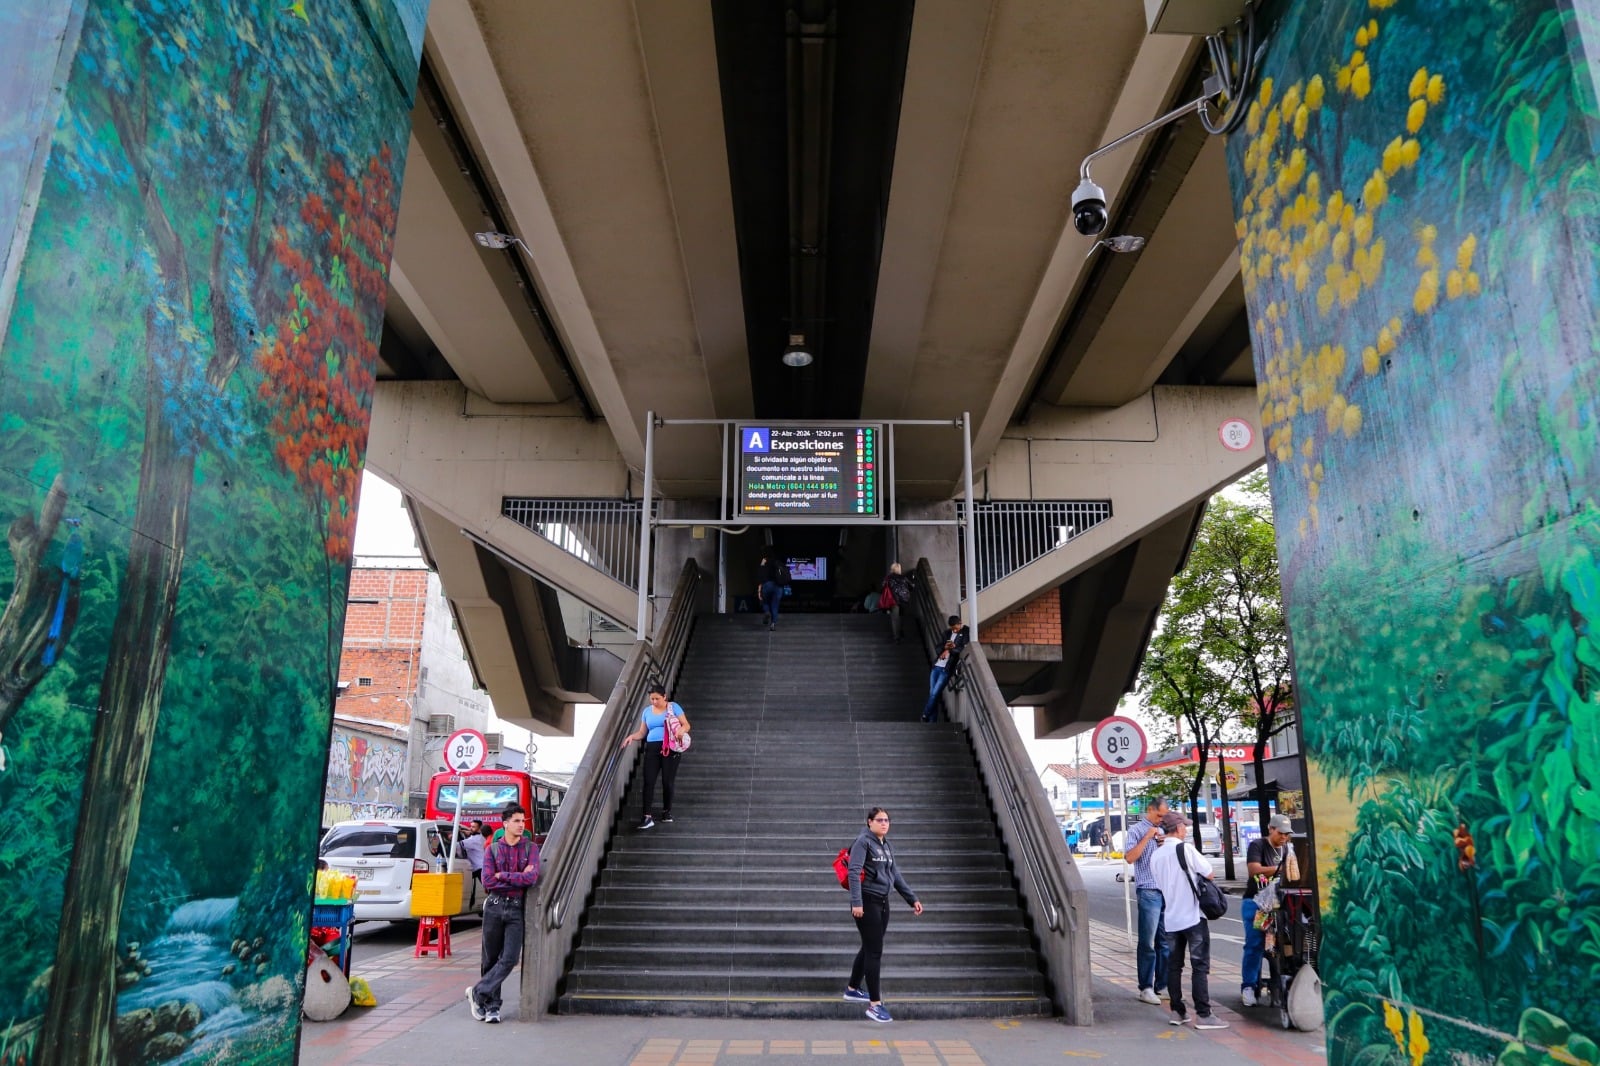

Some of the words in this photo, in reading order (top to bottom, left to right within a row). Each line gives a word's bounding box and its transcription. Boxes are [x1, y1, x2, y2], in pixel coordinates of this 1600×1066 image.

[749, 431, 763, 449] A
[771, 440, 844, 451] Exposiciones
[807, 456, 827, 464] objeto
[814, 465, 840, 473] sistema,
[748, 482, 764, 490] Hola
[766, 482, 786, 490] Metro
[748, 491, 768, 499] donde
[790, 492, 820, 500] averiguar
[820, 491, 827, 499] si
[827, 491, 838, 499] fue
